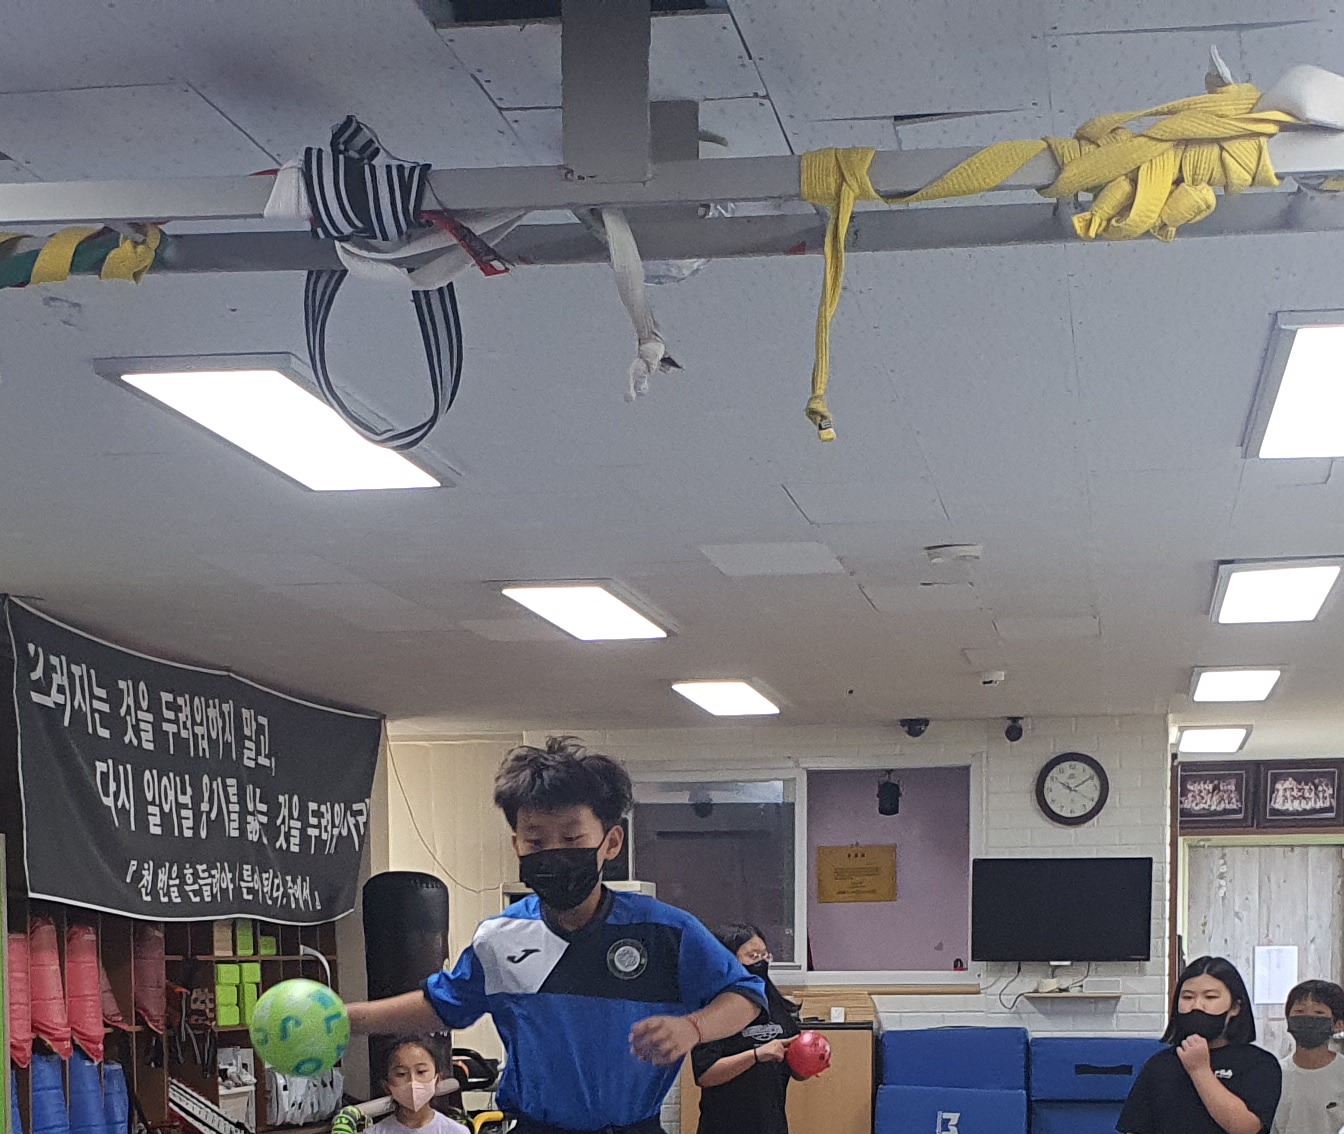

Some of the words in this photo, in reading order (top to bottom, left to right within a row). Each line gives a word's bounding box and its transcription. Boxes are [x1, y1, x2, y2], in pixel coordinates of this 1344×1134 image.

[117, 679, 155, 751] 것을
[159, 690, 237, 762] 두려워하지
[241, 707, 276, 777] 말고,
[95, 758, 136, 832] 다시
[143, 769, 194, 838] 일어날
[200, 773, 240, 840] 용기를
[276, 793, 302, 853] 것을
[157, 861, 182, 903] 번을
[183, 862, 235, 903] 흔들려야
